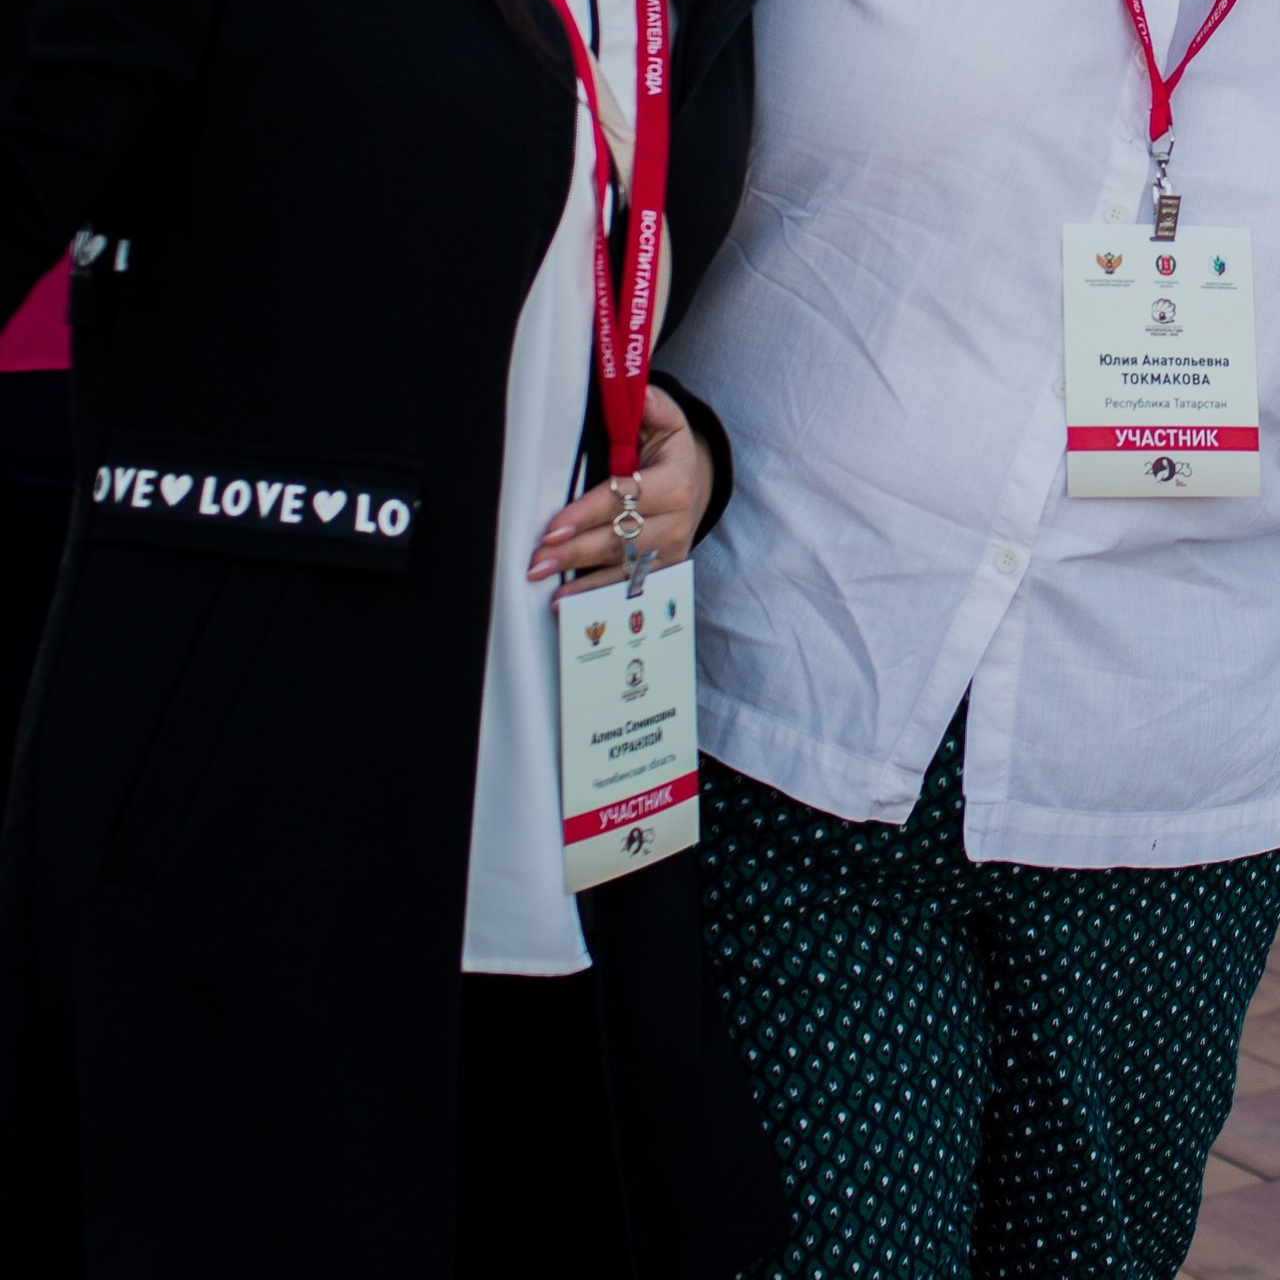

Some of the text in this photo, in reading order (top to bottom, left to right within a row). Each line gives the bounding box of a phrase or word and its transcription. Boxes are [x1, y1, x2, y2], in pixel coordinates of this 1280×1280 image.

[644, 57, 663, 96] ГОДА
[625, 209, 657, 378] ВОСПИТАТЕЛЬ ГОДА
[1099, 354, 1230, 367] Юлия Анатольевна
[1121, 373, 1211, 386] ТОКМАКОВА
[1105, 397, 1227, 412] Республика Татарстан
[1115, 428, 1219, 447] УЧАСТНИК
[199, 476, 307, 523] LOVE
[354, 492, 421, 537] LO
[599, 785, 673, 830] УЧАСТНИК
